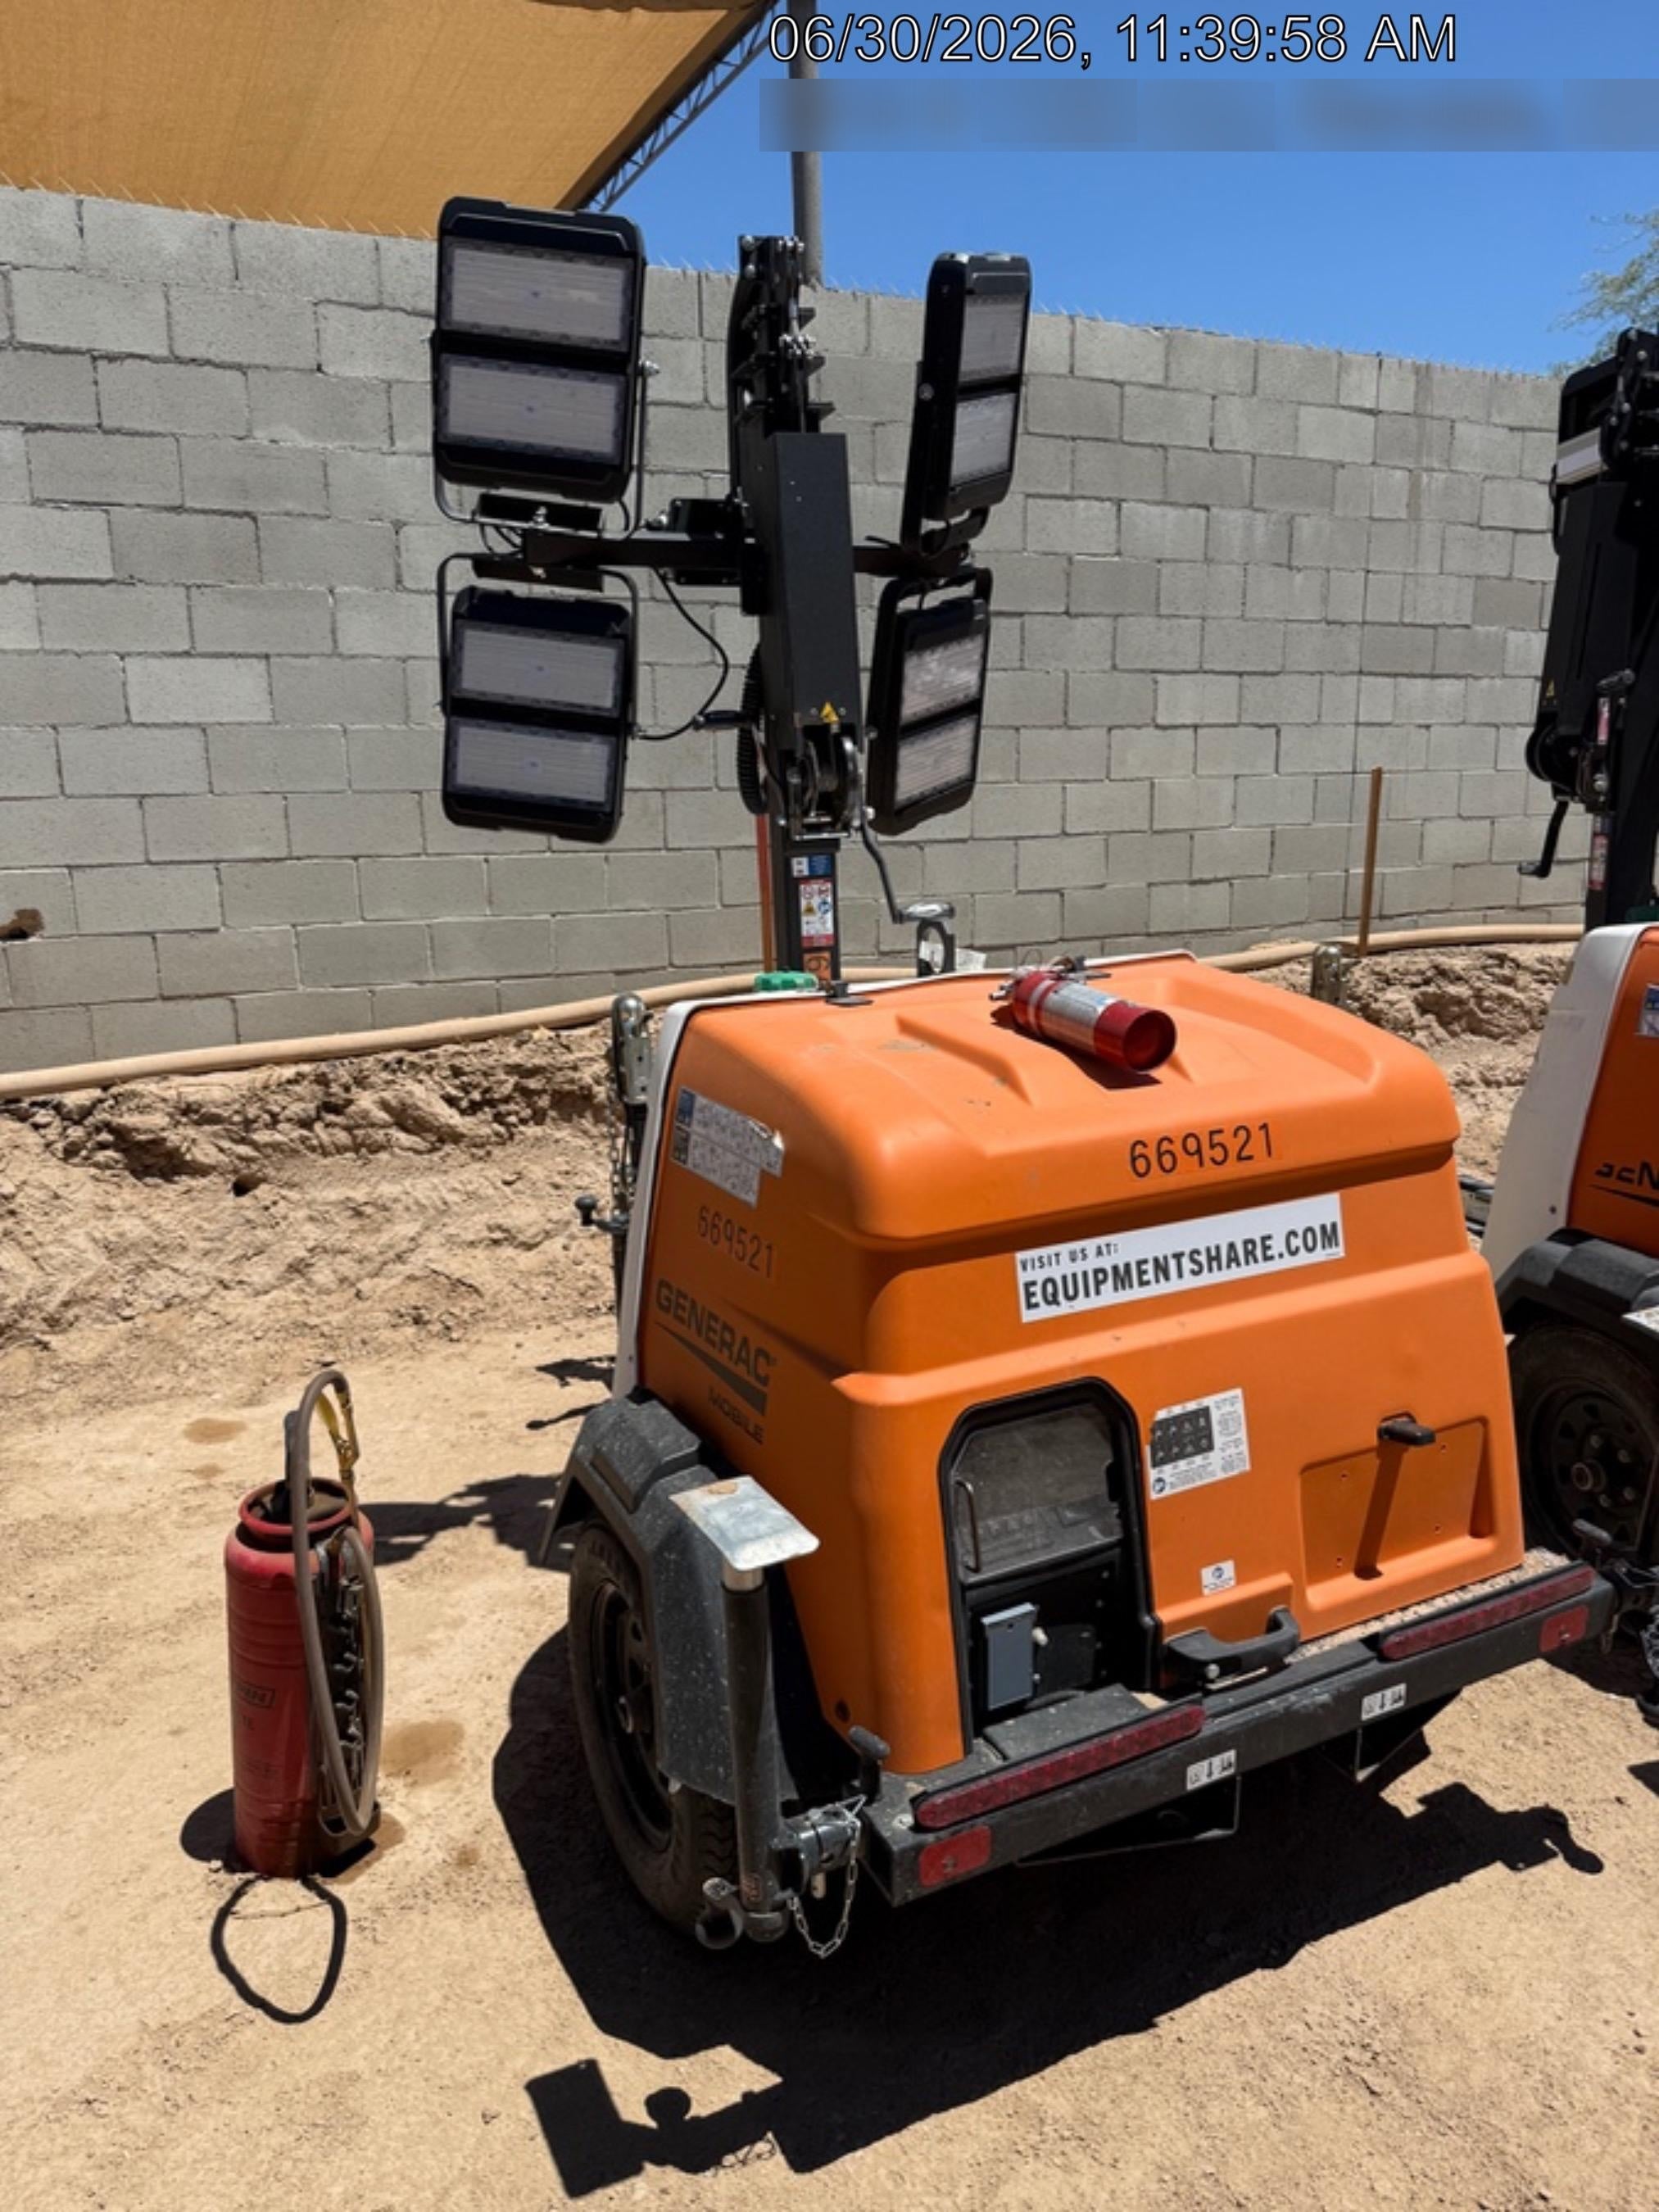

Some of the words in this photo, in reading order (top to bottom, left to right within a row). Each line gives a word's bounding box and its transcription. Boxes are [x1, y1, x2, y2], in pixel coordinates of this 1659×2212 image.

[1130, 1122, 1273, 1178] 669521
[698, 1205, 774, 1278] 669521
[1021, 1253, 1062, 1271] VISIT
[1068, 1247, 1088, 1264] US
[1095, 1243, 1119, 1258] AT:
[1023, 1222, 1339, 1311] EQUIPMENTSHARE.COM
[656, 1277, 772, 1387] GENERAC
[709, 1385, 765, 1446] MOBILE
